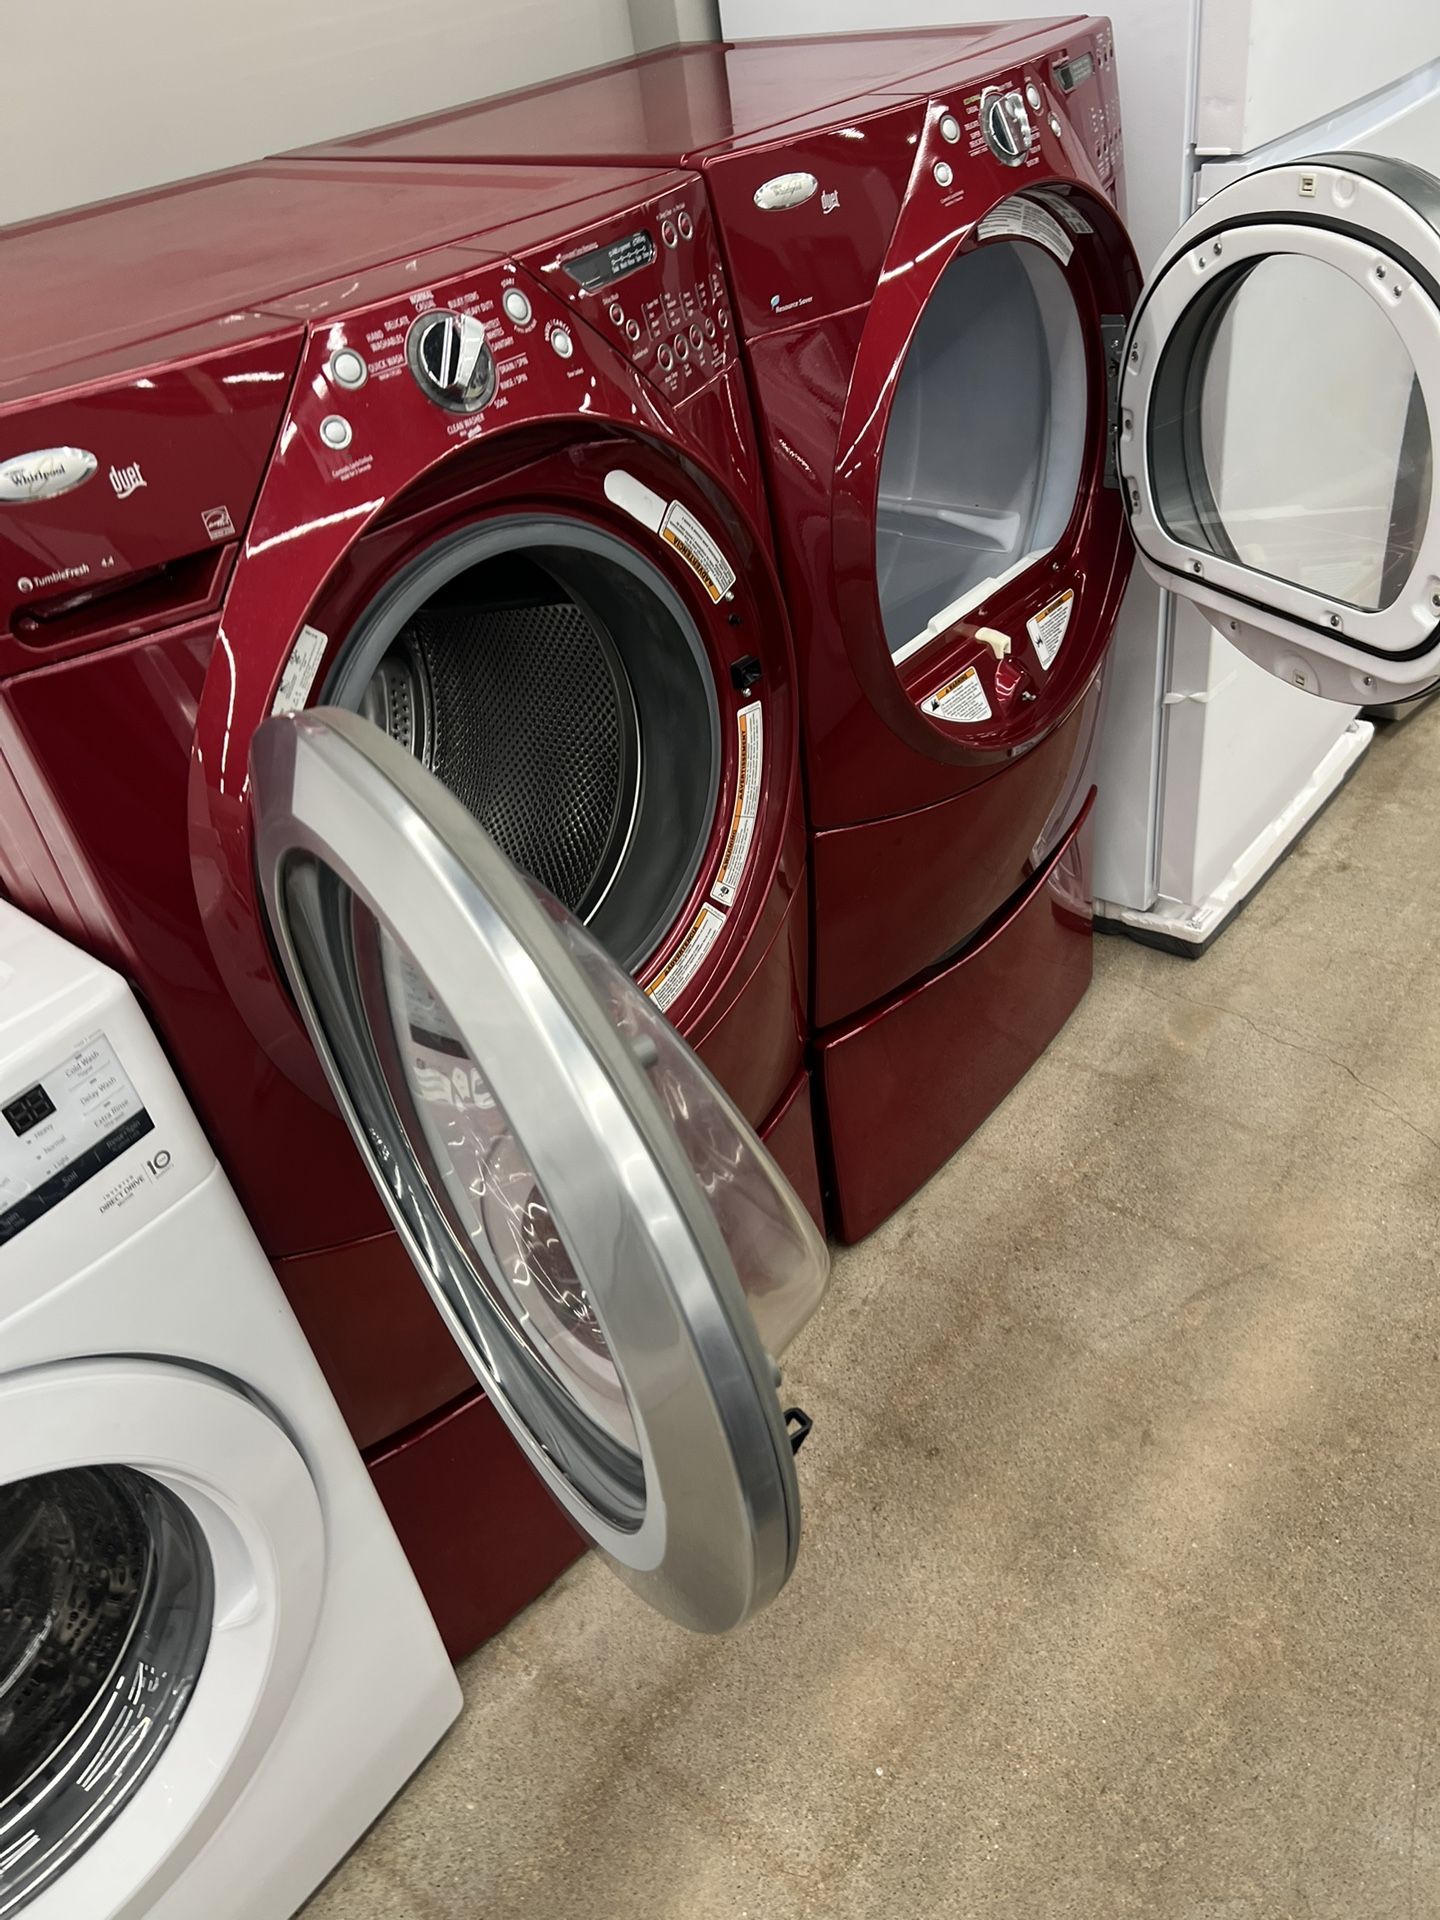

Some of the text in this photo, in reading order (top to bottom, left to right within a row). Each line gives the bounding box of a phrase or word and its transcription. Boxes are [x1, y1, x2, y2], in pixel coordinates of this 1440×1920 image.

[11, 464, 66, 487] Whirlpool
[109, 461, 147, 499] duet
[34, 563, 90, 587] TumbleFresh
[81, 1050, 99, 1067] Wash
[98, 1076, 117, 1093] Wash
[99, 1174, 145, 1213] DIRECT DRIVE
